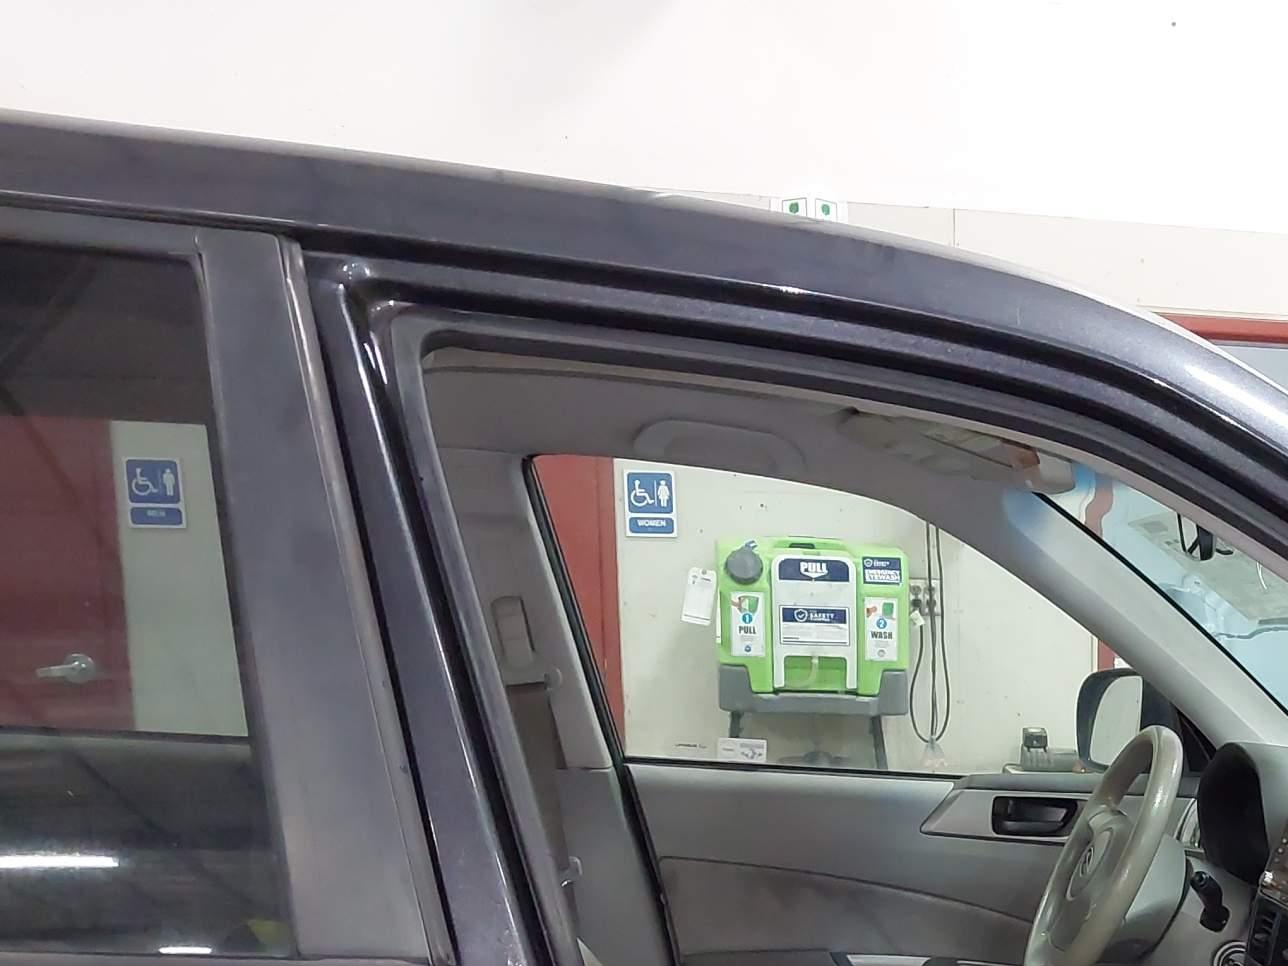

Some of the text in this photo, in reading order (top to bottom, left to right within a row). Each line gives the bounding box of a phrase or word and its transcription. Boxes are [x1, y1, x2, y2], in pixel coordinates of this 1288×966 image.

[637, 519, 666, 527] WOMEN
[800, 561, 828, 573] PULL
[739, 625, 756, 634] PULL
[871, 631, 893, 640] WASH
